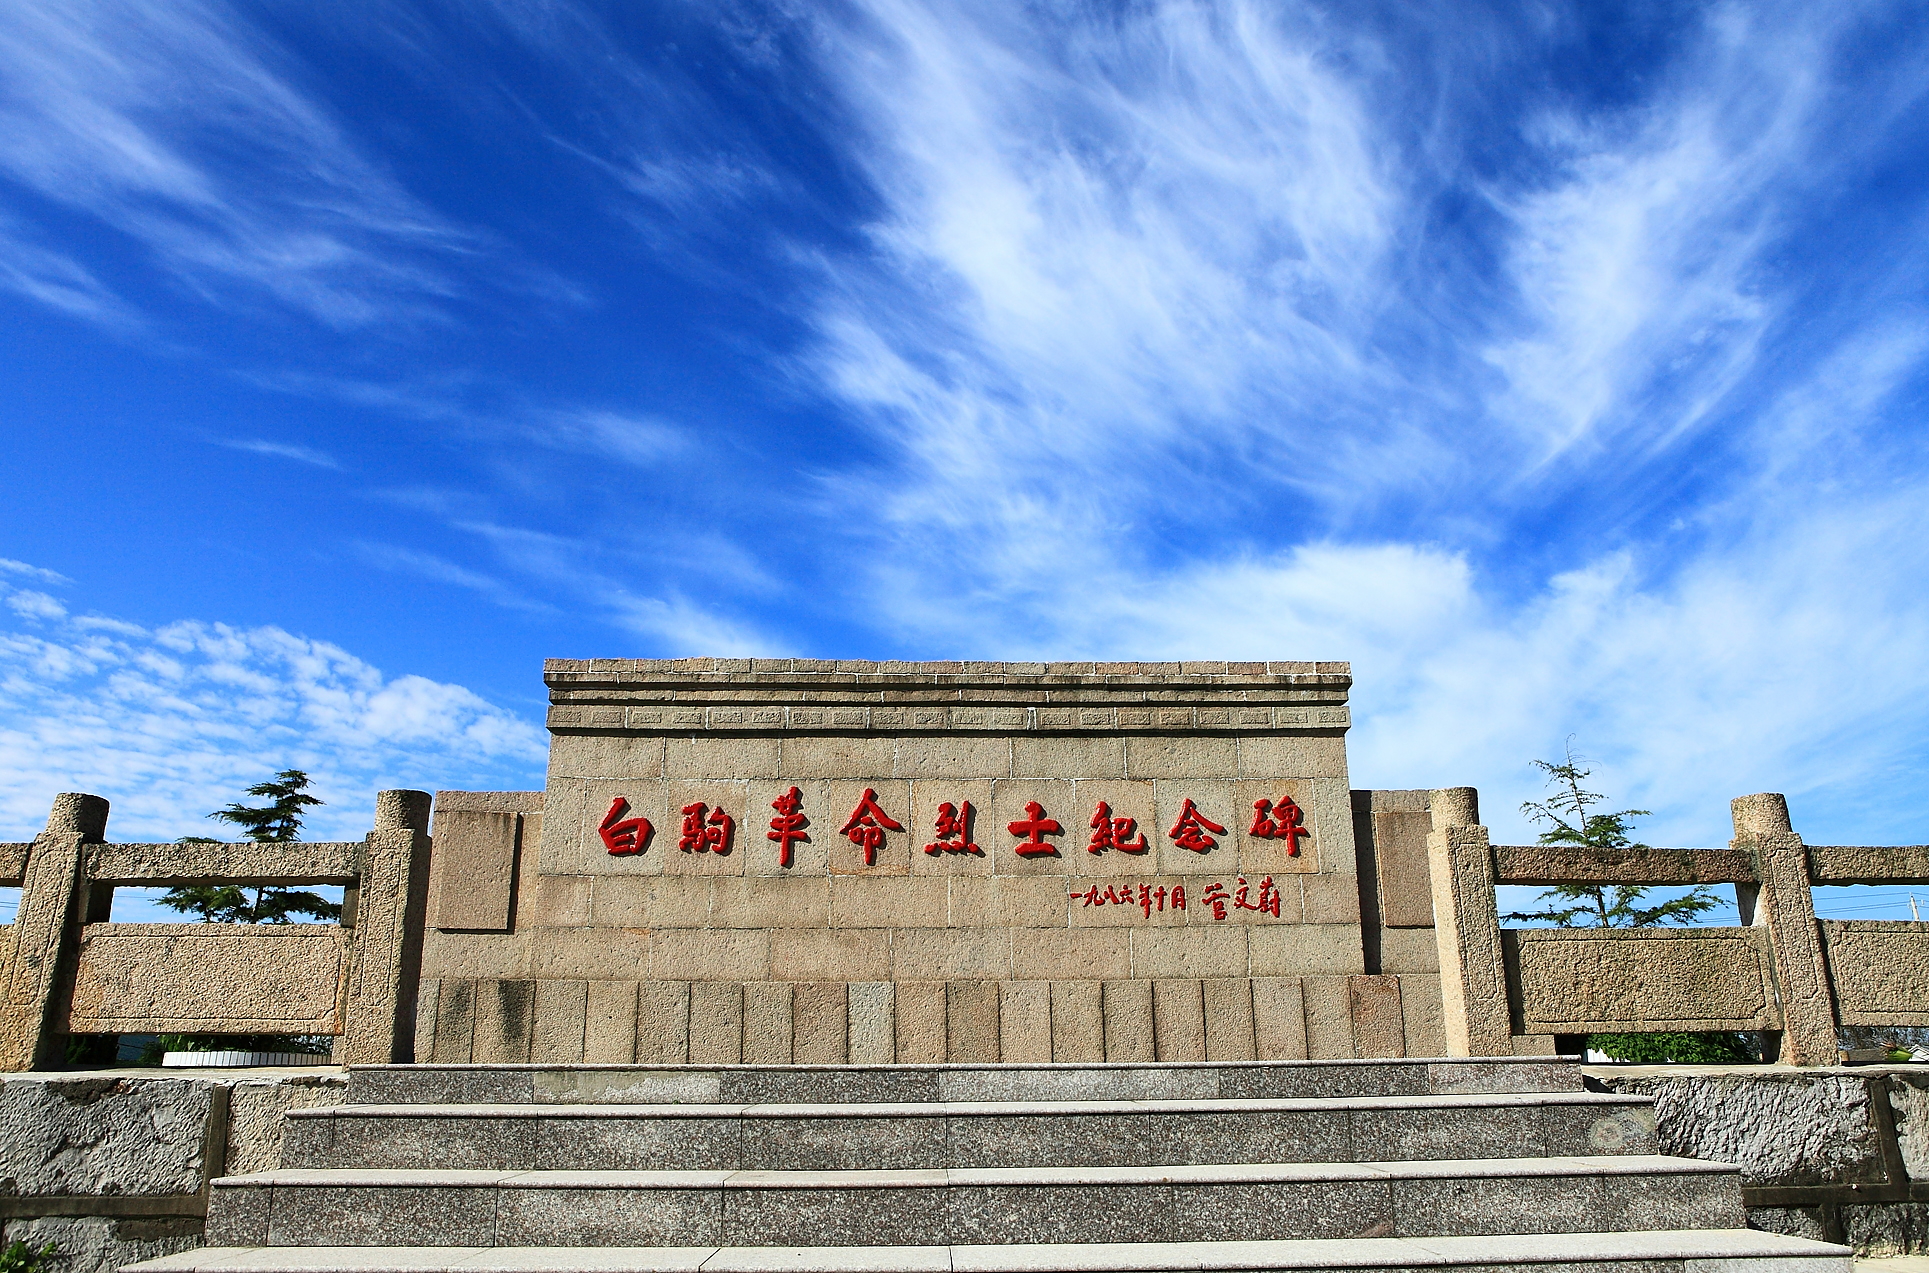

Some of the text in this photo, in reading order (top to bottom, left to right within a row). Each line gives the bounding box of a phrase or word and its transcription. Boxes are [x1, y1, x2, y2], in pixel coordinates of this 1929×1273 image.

[1070, 883, 1187, 919] 一九八六年十月
